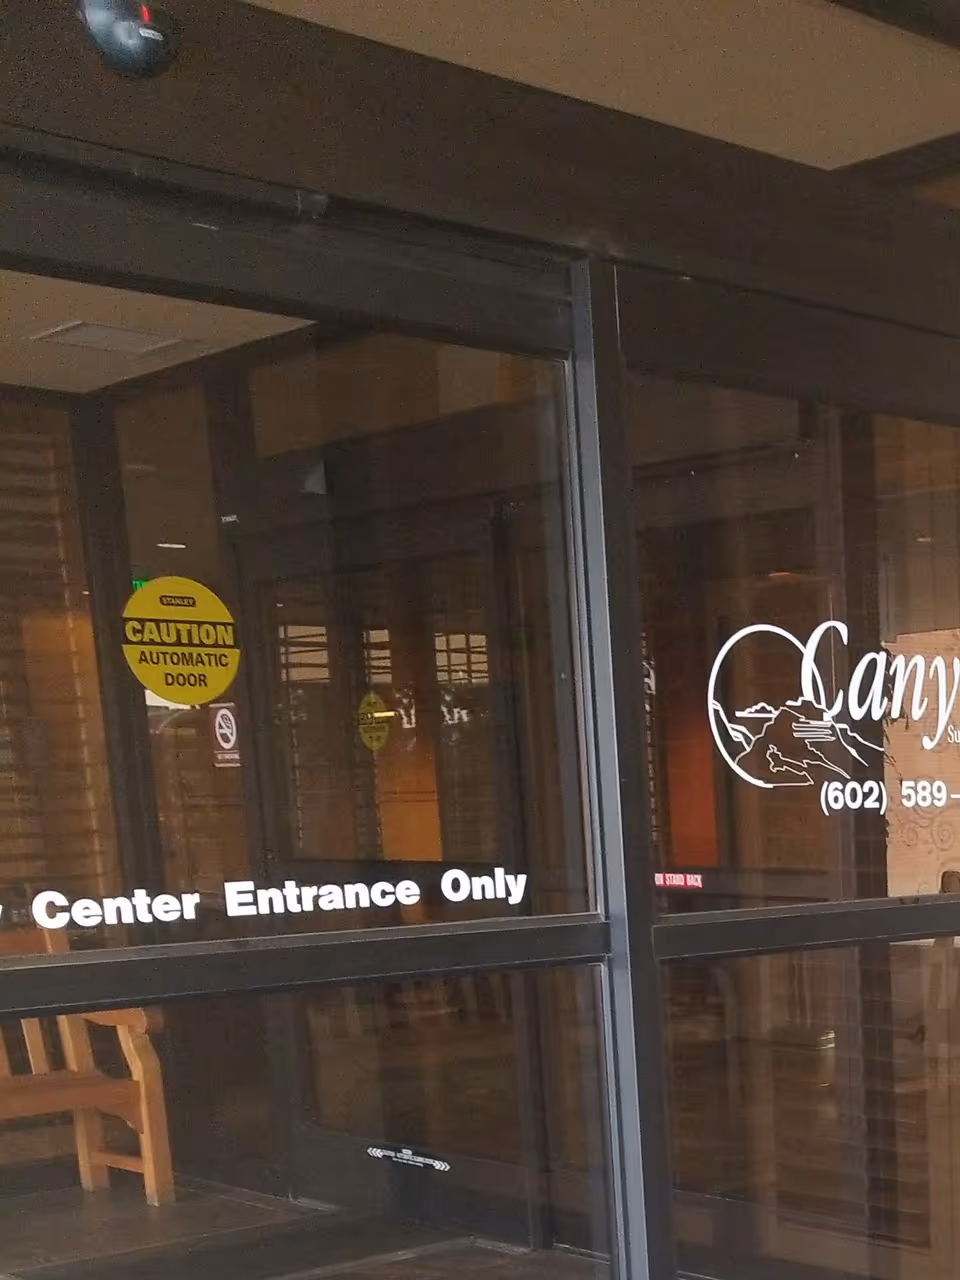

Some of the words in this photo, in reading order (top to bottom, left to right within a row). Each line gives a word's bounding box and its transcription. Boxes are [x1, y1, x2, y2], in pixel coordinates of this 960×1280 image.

[161, 596, 195, 606] STANLEY
[125, 620, 235, 646] CAUTION
[138, 650, 230, 668] AUTOMATIC
[164, 672, 208, 688] DOOR
[820, 780, 887, 816] (602)
[31, 888, 201, 930] Center
[223, 879, 421, 917] Entrance
[440, 867, 527, 905] Only
